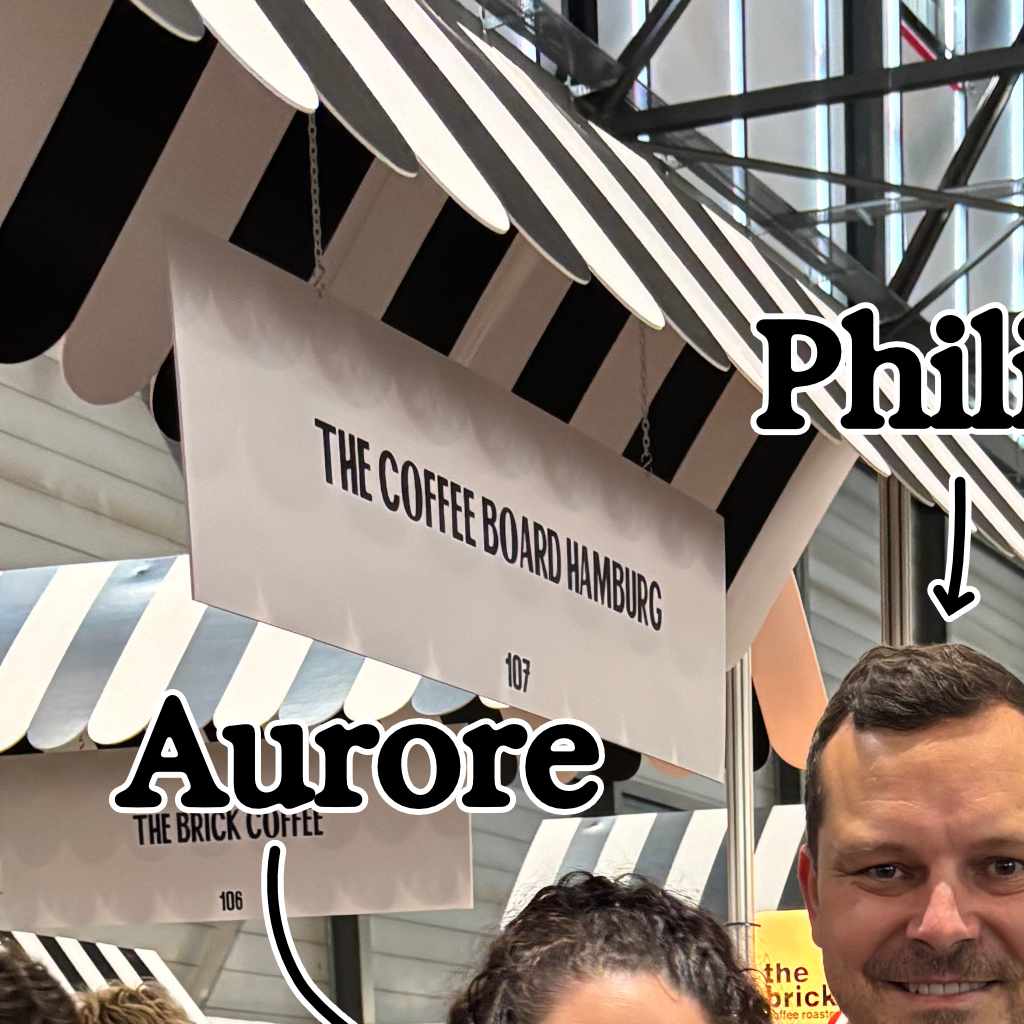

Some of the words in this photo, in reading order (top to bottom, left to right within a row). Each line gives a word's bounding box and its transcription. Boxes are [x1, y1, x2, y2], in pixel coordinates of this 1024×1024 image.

[314, 418, 372, 502] THE
[379, 450, 477, 547] COFFEE
[482, 496, 562, 584] BOARD
[566, 538, 662, 631] HAMBURG
[506, 652, 530, 693] 107
[134, 813, 172, 845] THE
[177, 811, 241, 843] BRICK
[246, 811, 324, 839] COFFEE
[220, 890, 243, 911] 106
[764, 963, 808, 983] the
[767, 984, 836, 1008] brick
